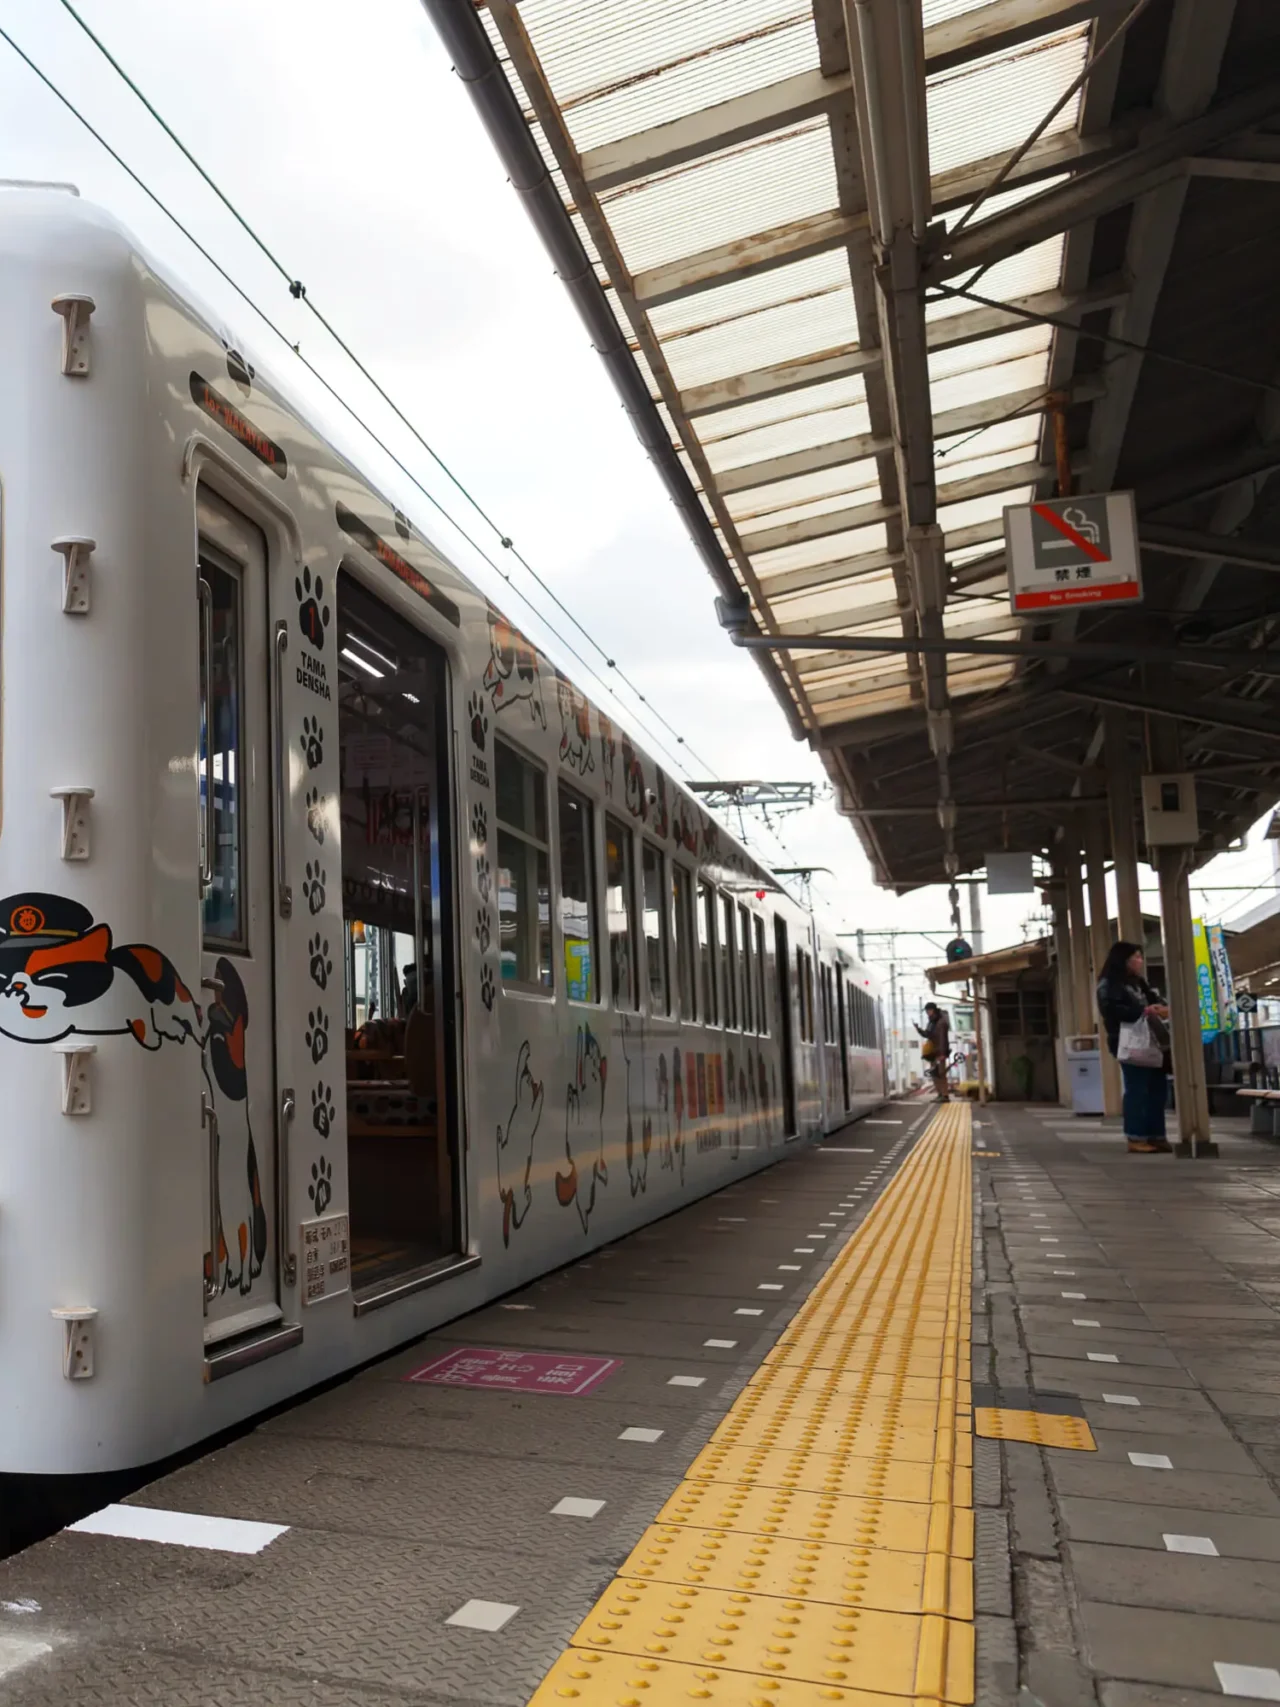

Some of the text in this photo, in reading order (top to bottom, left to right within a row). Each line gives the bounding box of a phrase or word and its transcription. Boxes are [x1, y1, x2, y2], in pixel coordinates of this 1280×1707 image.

[1055, 566, 1091, 581] 禁煙
[1065, 590, 1102, 599] Smoking
[301, 650, 327, 681] TAMA
[296, 667, 331, 701] DENSHA
